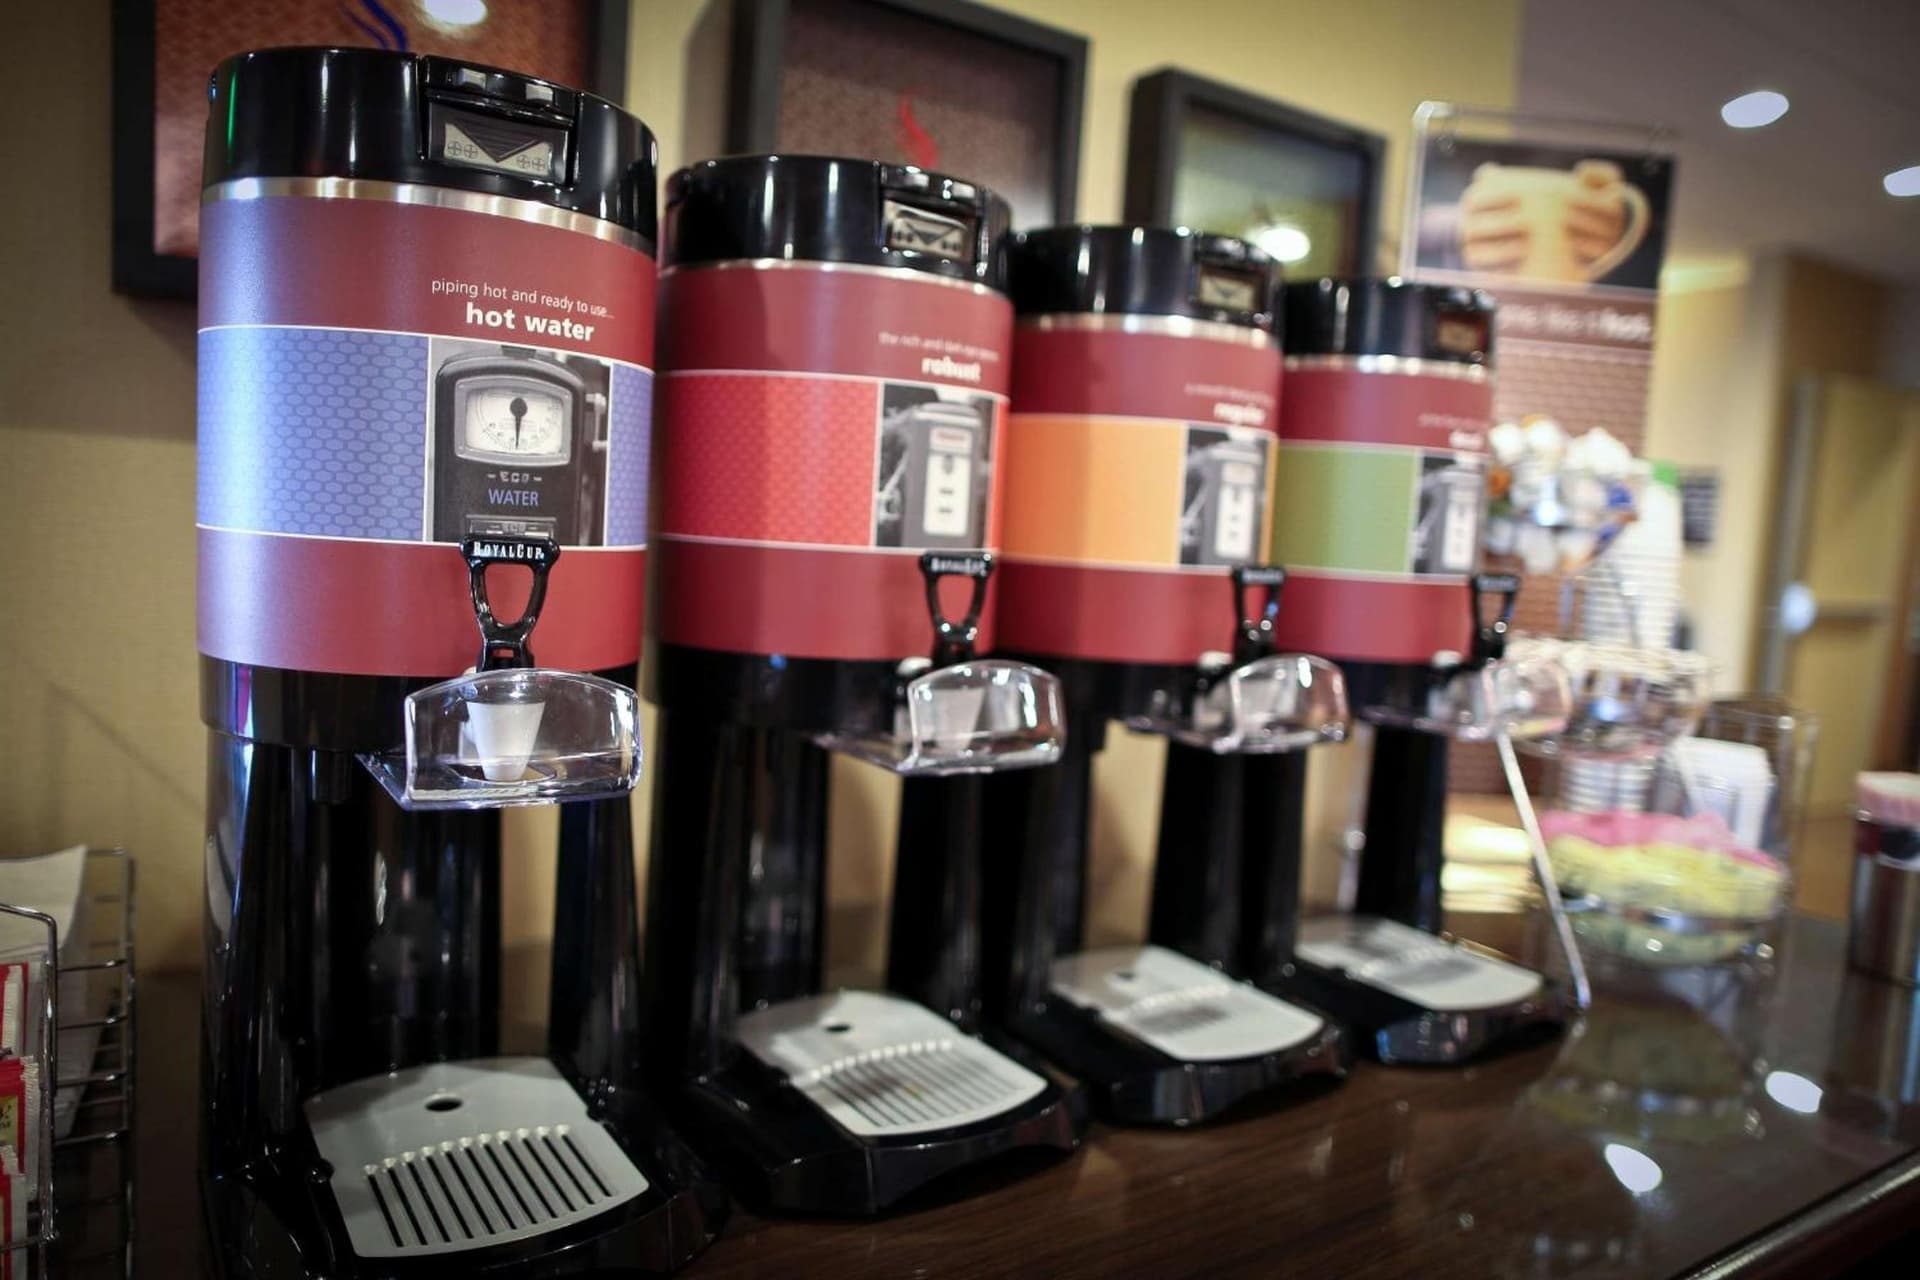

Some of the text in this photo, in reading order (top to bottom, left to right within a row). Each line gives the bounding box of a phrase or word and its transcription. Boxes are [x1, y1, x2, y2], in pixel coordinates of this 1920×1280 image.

[431, 279, 479, 298] piping
[483, 283, 507, 300] hot
[511, 290, 537, 304] and
[540, 294, 574, 313] ready
[577, 301, 589, 313] to
[465, 302, 594, 342] hot water
[921, 355, 981, 382] robust
[488, 488, 539, 506] WATER
